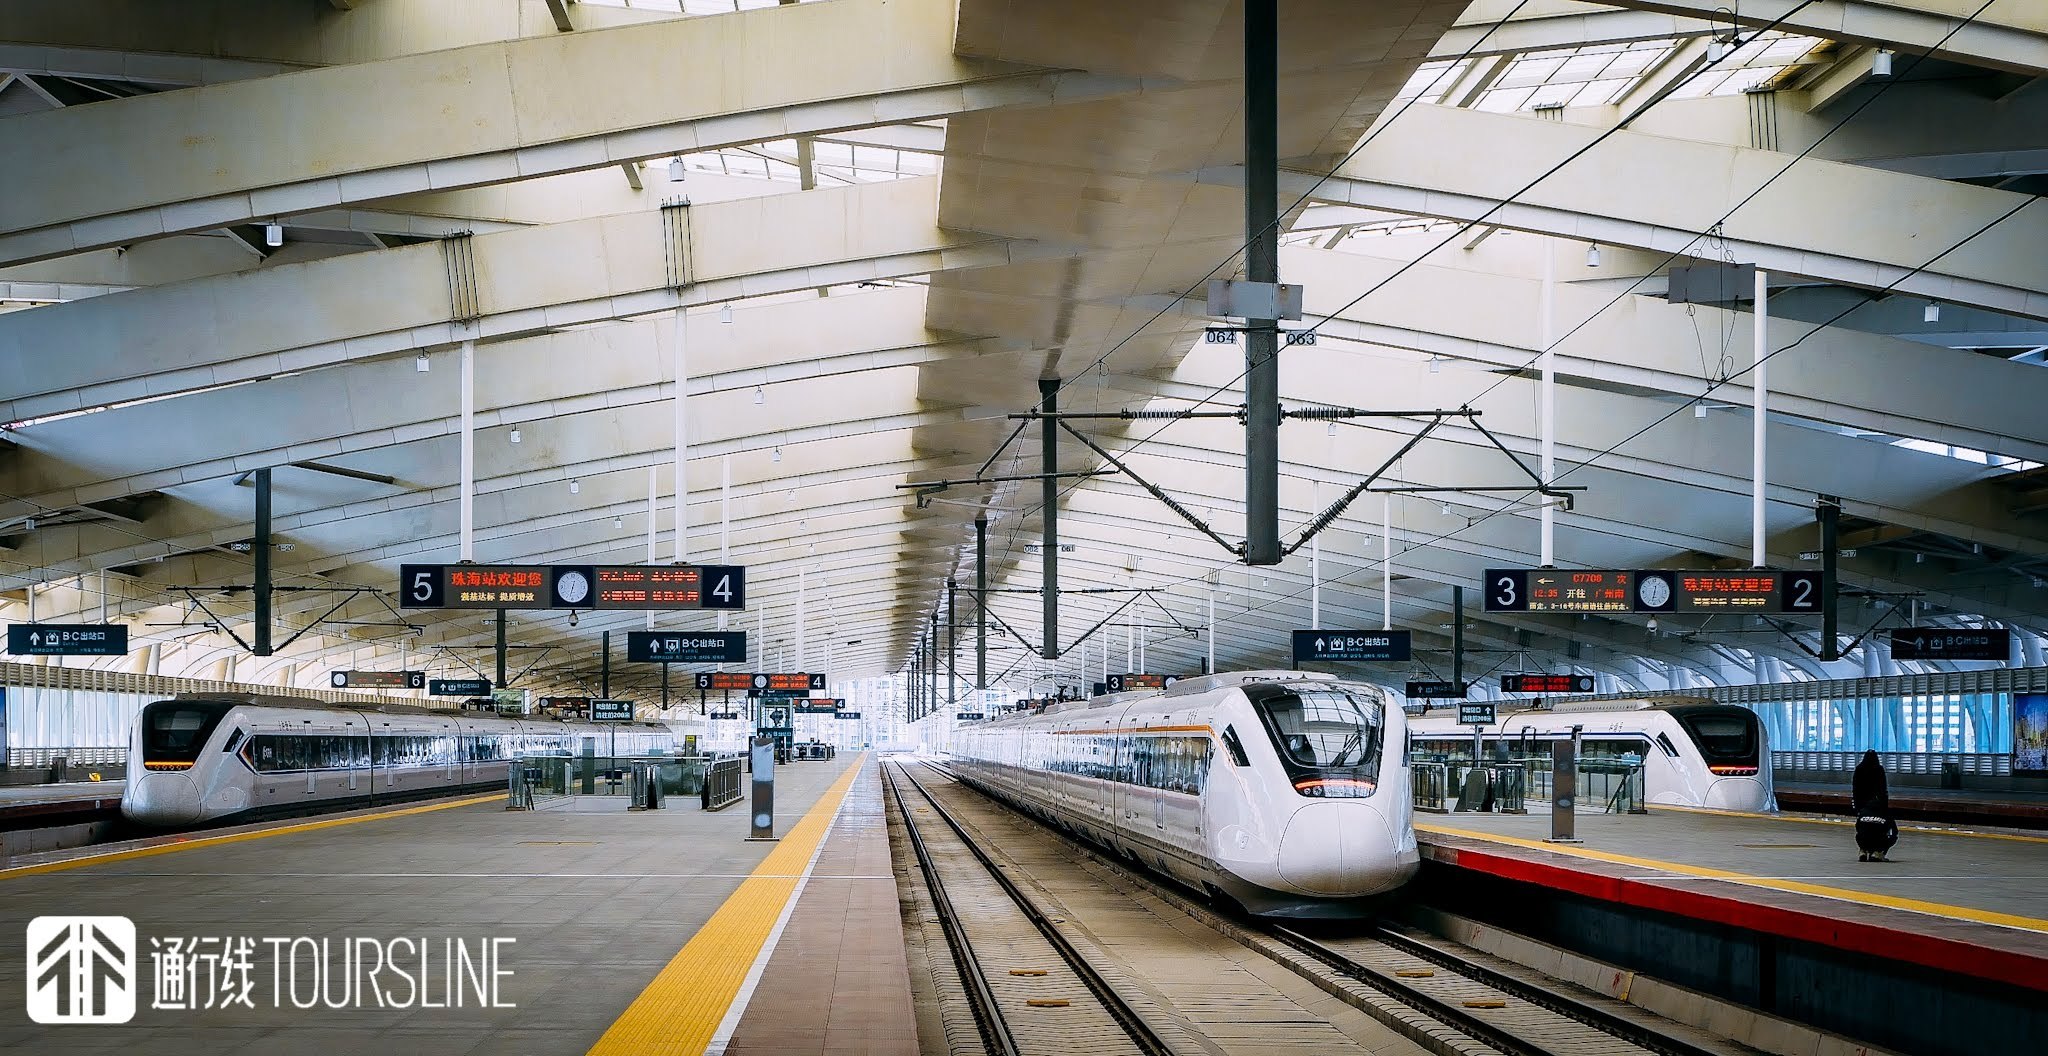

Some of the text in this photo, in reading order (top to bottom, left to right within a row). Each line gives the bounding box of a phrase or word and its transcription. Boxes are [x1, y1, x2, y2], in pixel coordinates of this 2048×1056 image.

[1206, 330, 1236, 344] 064
[1286, 332, 1316, 345] 063
[451, 571, 542, 586] 珠海站欢迎您
[1616, 574, 1627, 585] 次
[413, 572, 433, 601] 5
[712, 574, 733, 603] 4
[1496, 576, 1516, 606] 3
[1793, 578, 1813, 607] 2
[1566, 588, 1586, 599] 开往
[412, 675, 421, 686] 6
[699, 675, 708, 687] 5
[812, 676, 822, 688] 4
[1110, 676, 1119, 689] 3
[1506, 678, 1513, 690] 1
